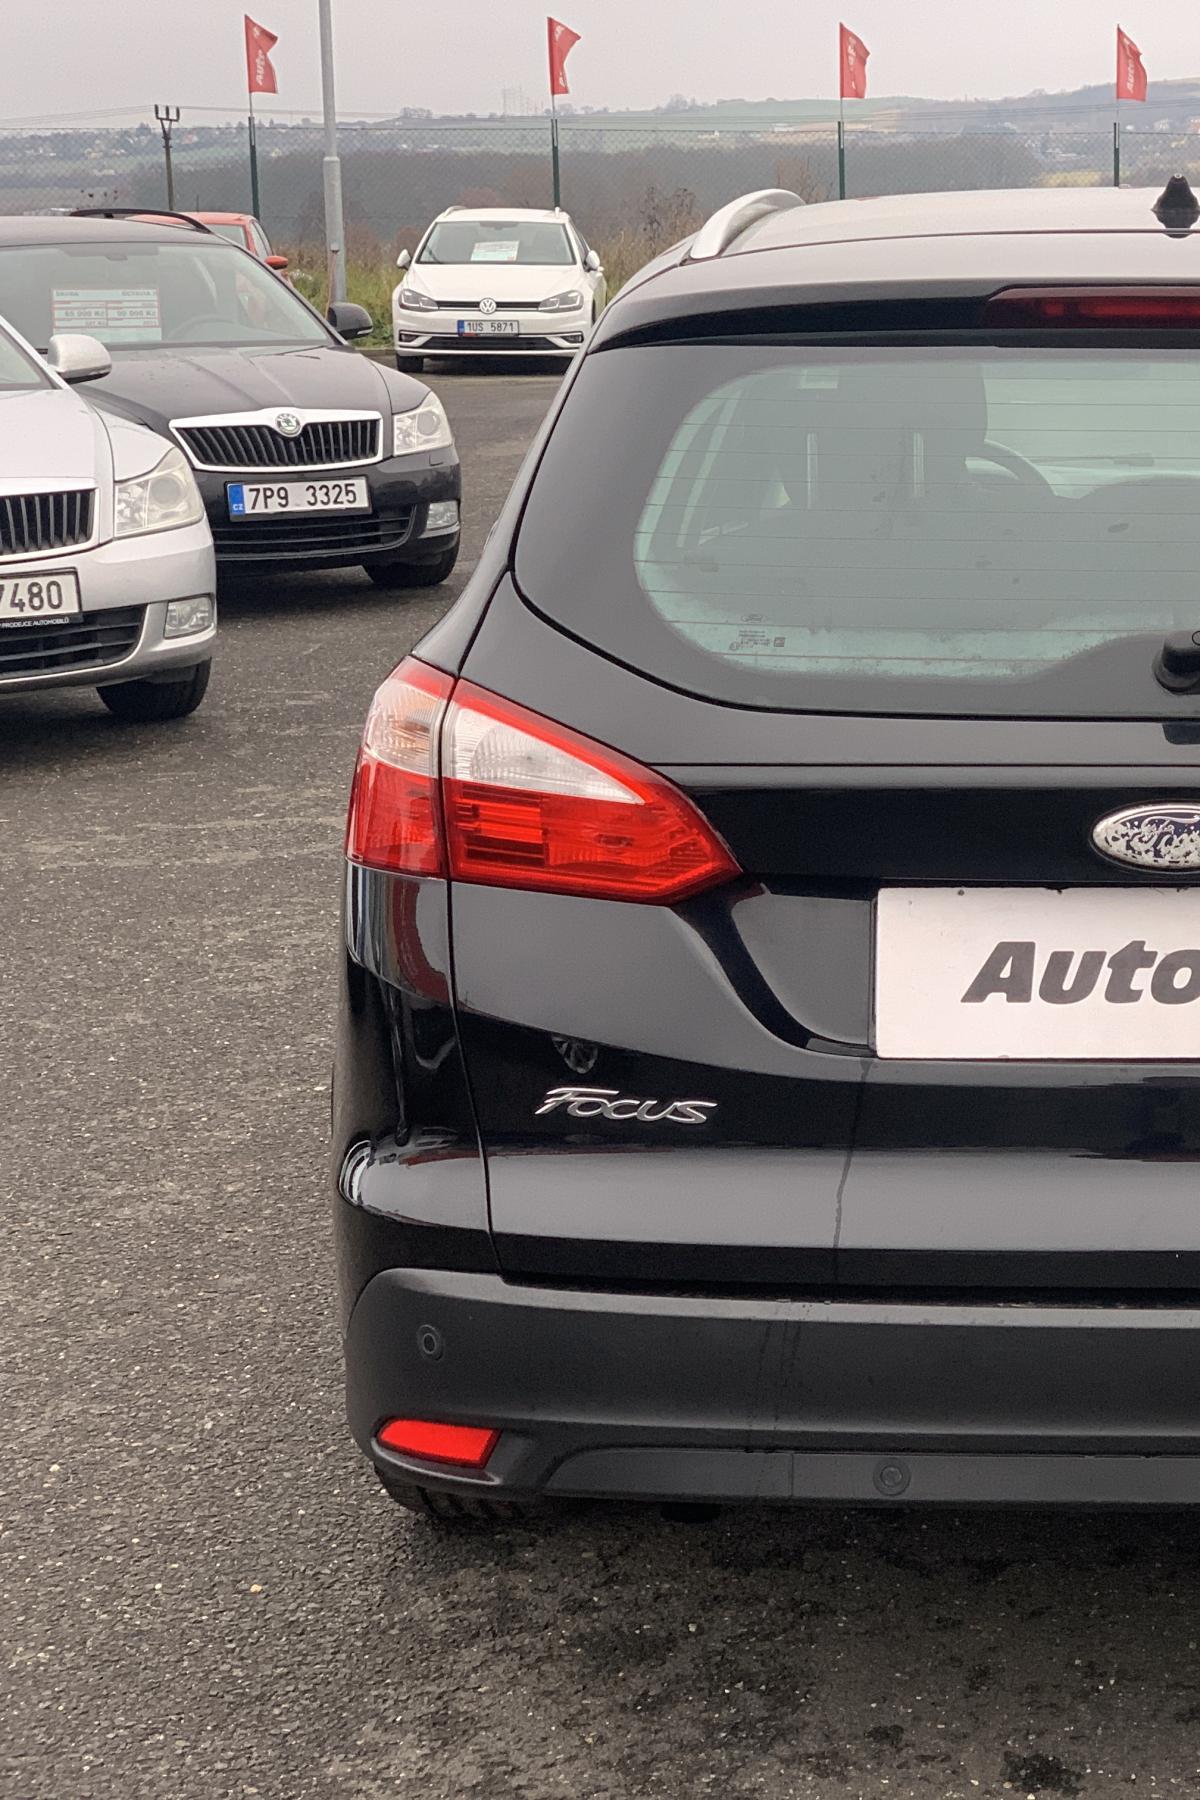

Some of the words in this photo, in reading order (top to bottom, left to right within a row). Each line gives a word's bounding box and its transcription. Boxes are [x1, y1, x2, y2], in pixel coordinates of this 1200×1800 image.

[467, 322, 484, 332] 1US
[490, 322, 515, 332] 5871
[248, 486, 290, 510] 7P9
[305, 482, 358, 506] 3325
[232, 503, 245, 511] CZ
